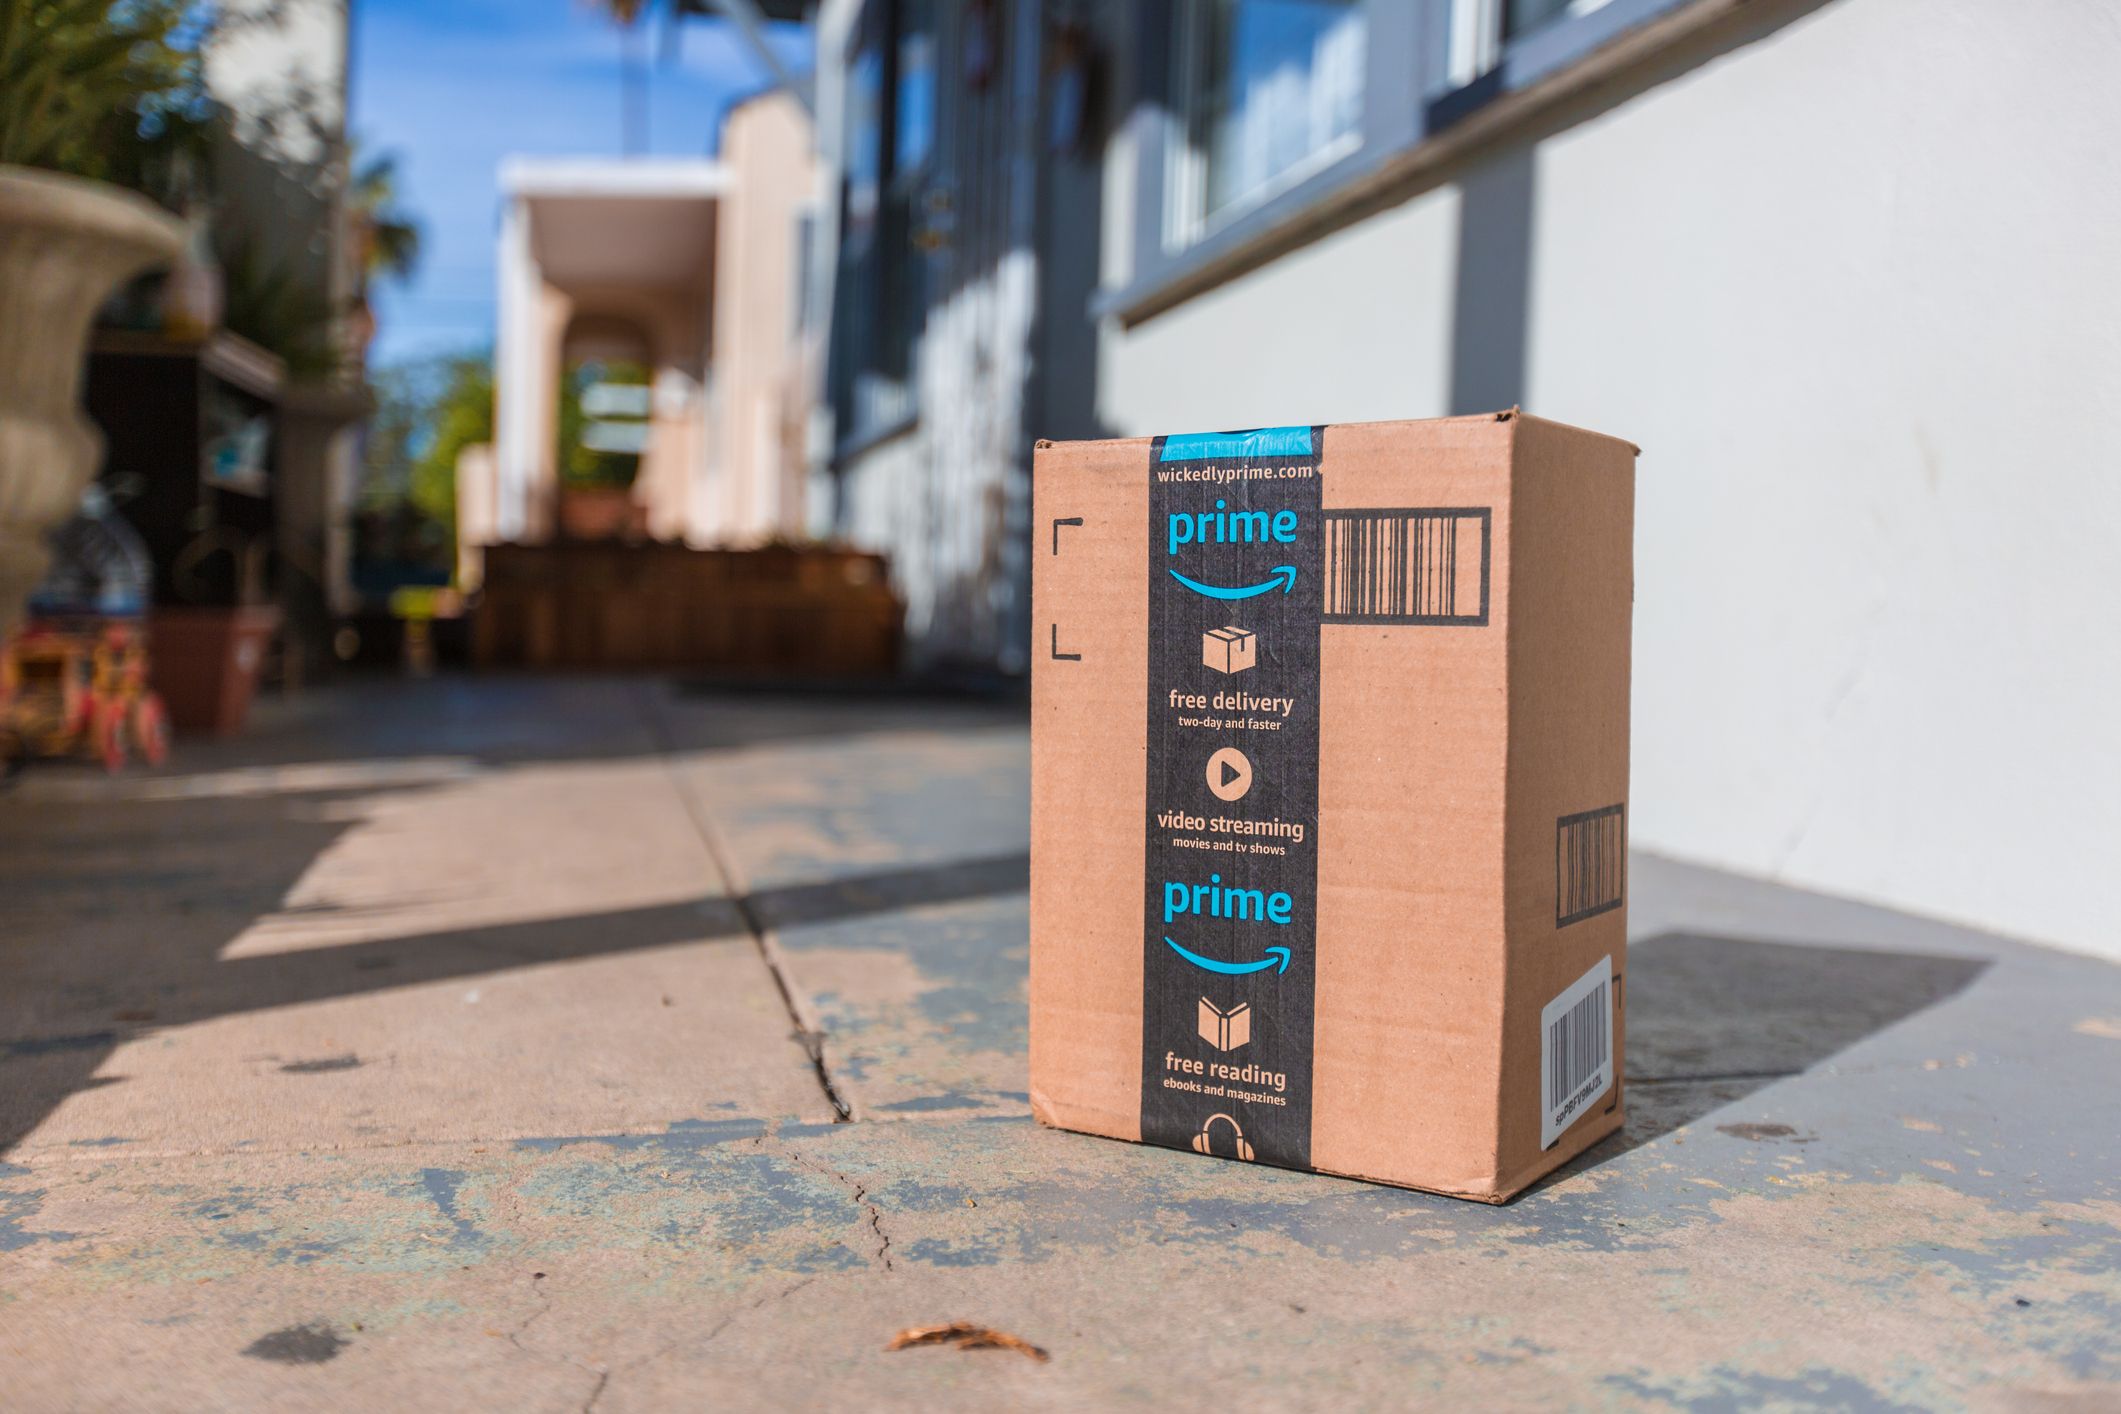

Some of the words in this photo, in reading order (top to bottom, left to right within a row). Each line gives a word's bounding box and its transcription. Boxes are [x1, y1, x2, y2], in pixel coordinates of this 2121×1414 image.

[1158, 465, 1313, 484] wickedlyprime.com
[1169, 500, 1298, 555] prime
[1169, 689, 1207, 709] free
[1212, 691, 1294, 717] delivery
[1178, 716, 1222, 730] two-day
[1225, 718, 1245, 729] and
[1248, 718, 1282, 731] faster
[1157, 810, 1206, 831] video
[1209, 816, 1304, 843] streaming
[1173, 837, 1211, 850] movies
[1213, 840, 1233, 852] and
[1235, 842, 1247, 853] tv
[1250, 843, 1286, 856] shows
[1164, 874, 1292, 924] prime
[1165, 1051, 1204, 1075] free
[1209, 1064, 1286, 1092] reading
[1163, 1078, 1202, 1093] ebooks
[1204, 1085, 1224, 1097] and
[1227, 1089, 1287, 1106] magazines
